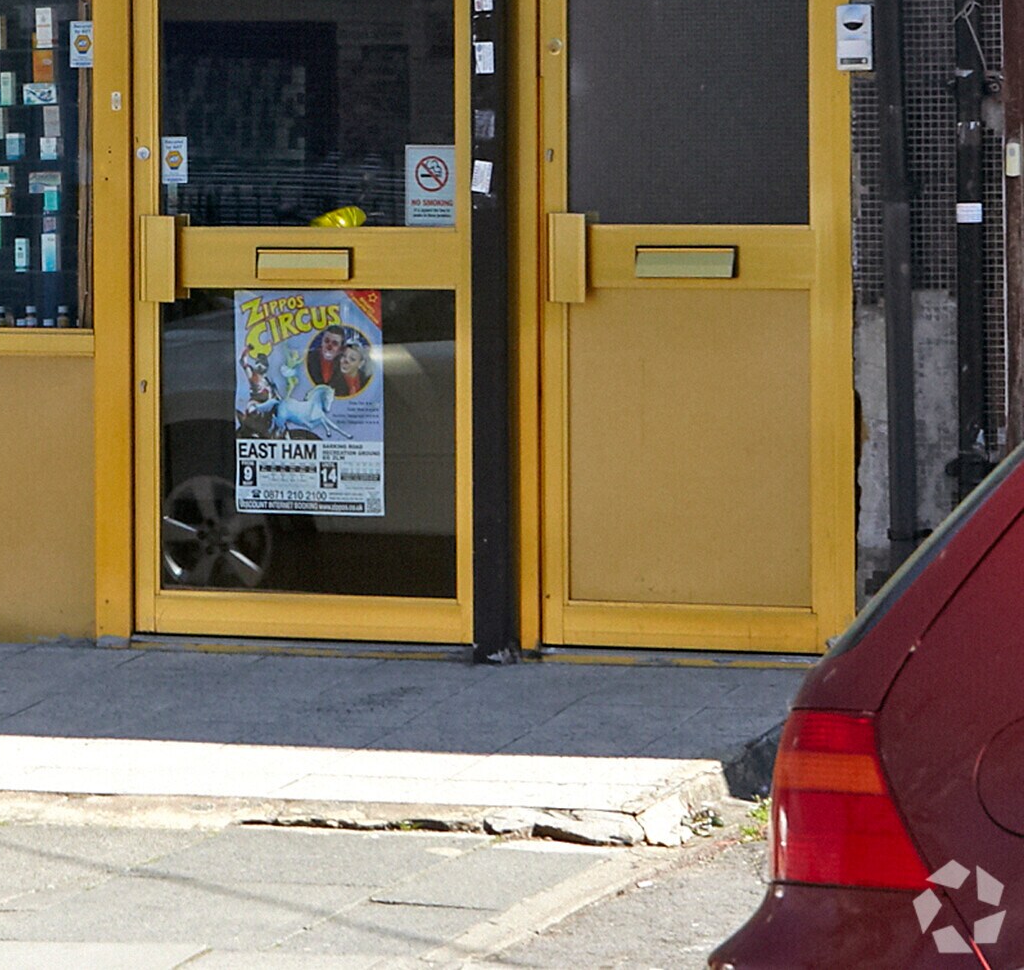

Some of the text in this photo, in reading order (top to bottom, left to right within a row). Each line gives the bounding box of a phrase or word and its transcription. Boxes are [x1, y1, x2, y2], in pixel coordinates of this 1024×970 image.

[241, 294, 305, 328] ZIPPOS
[245, 303, 343, 360] CIRCUS
[238, 442, 317, 460] EAST HAM
[243, 466, 253, 481] 9
[321, 468, 337, 484] 14
[287, 490, 306, 499] 210
